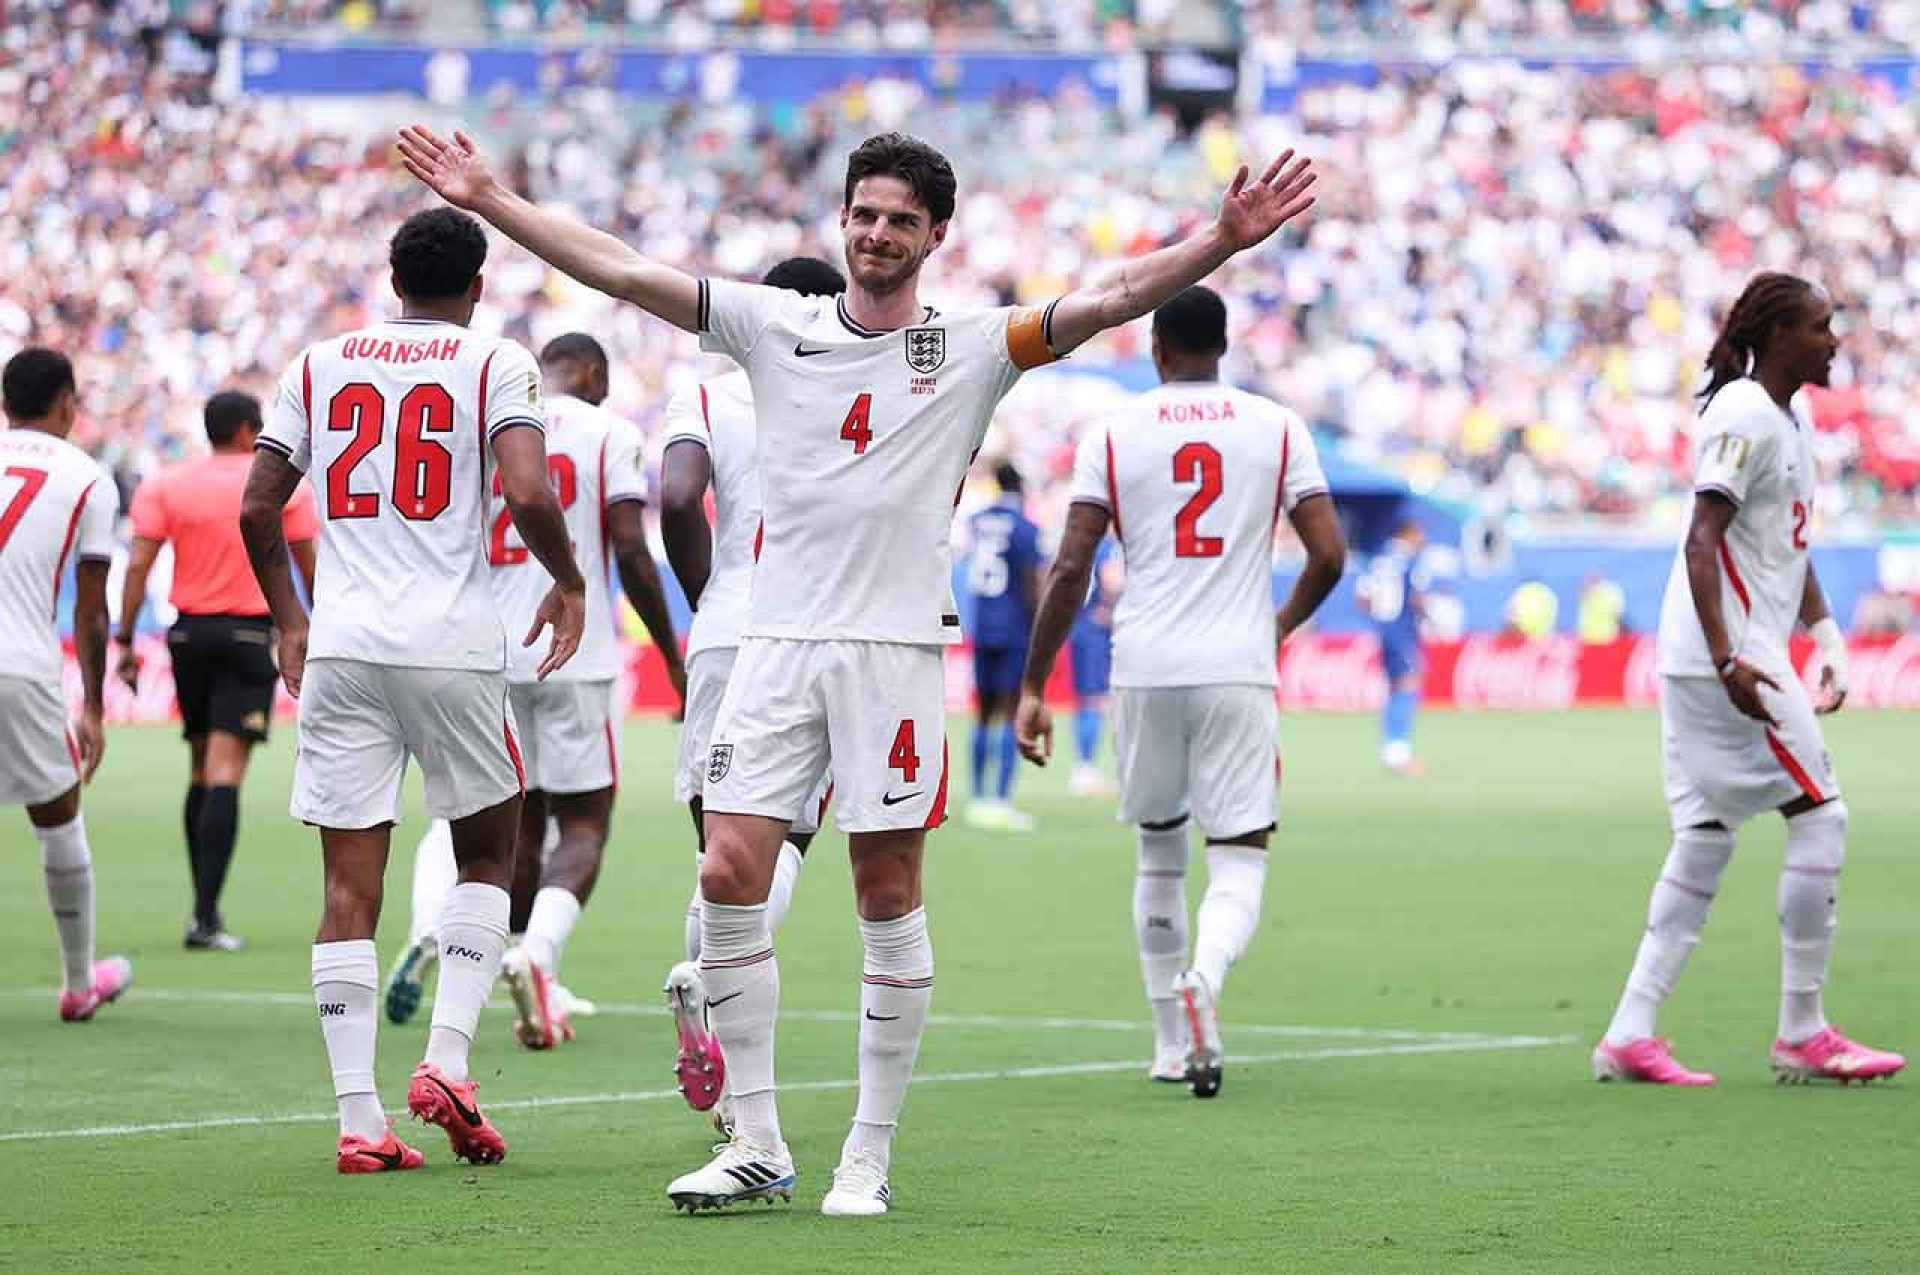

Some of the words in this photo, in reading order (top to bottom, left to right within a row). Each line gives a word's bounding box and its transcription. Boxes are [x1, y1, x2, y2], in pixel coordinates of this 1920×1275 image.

[341, 337, 461, 364] QUANSAH
[840, 393, 873, 454] 4
[1158, 401, 1235, 422] KONSA
[326, 382, 455, 521] 26
[1172, 442, 1224, 558] 2
[887, 719, 920, 783] 4
[446, 944, 484, 962] ENG
